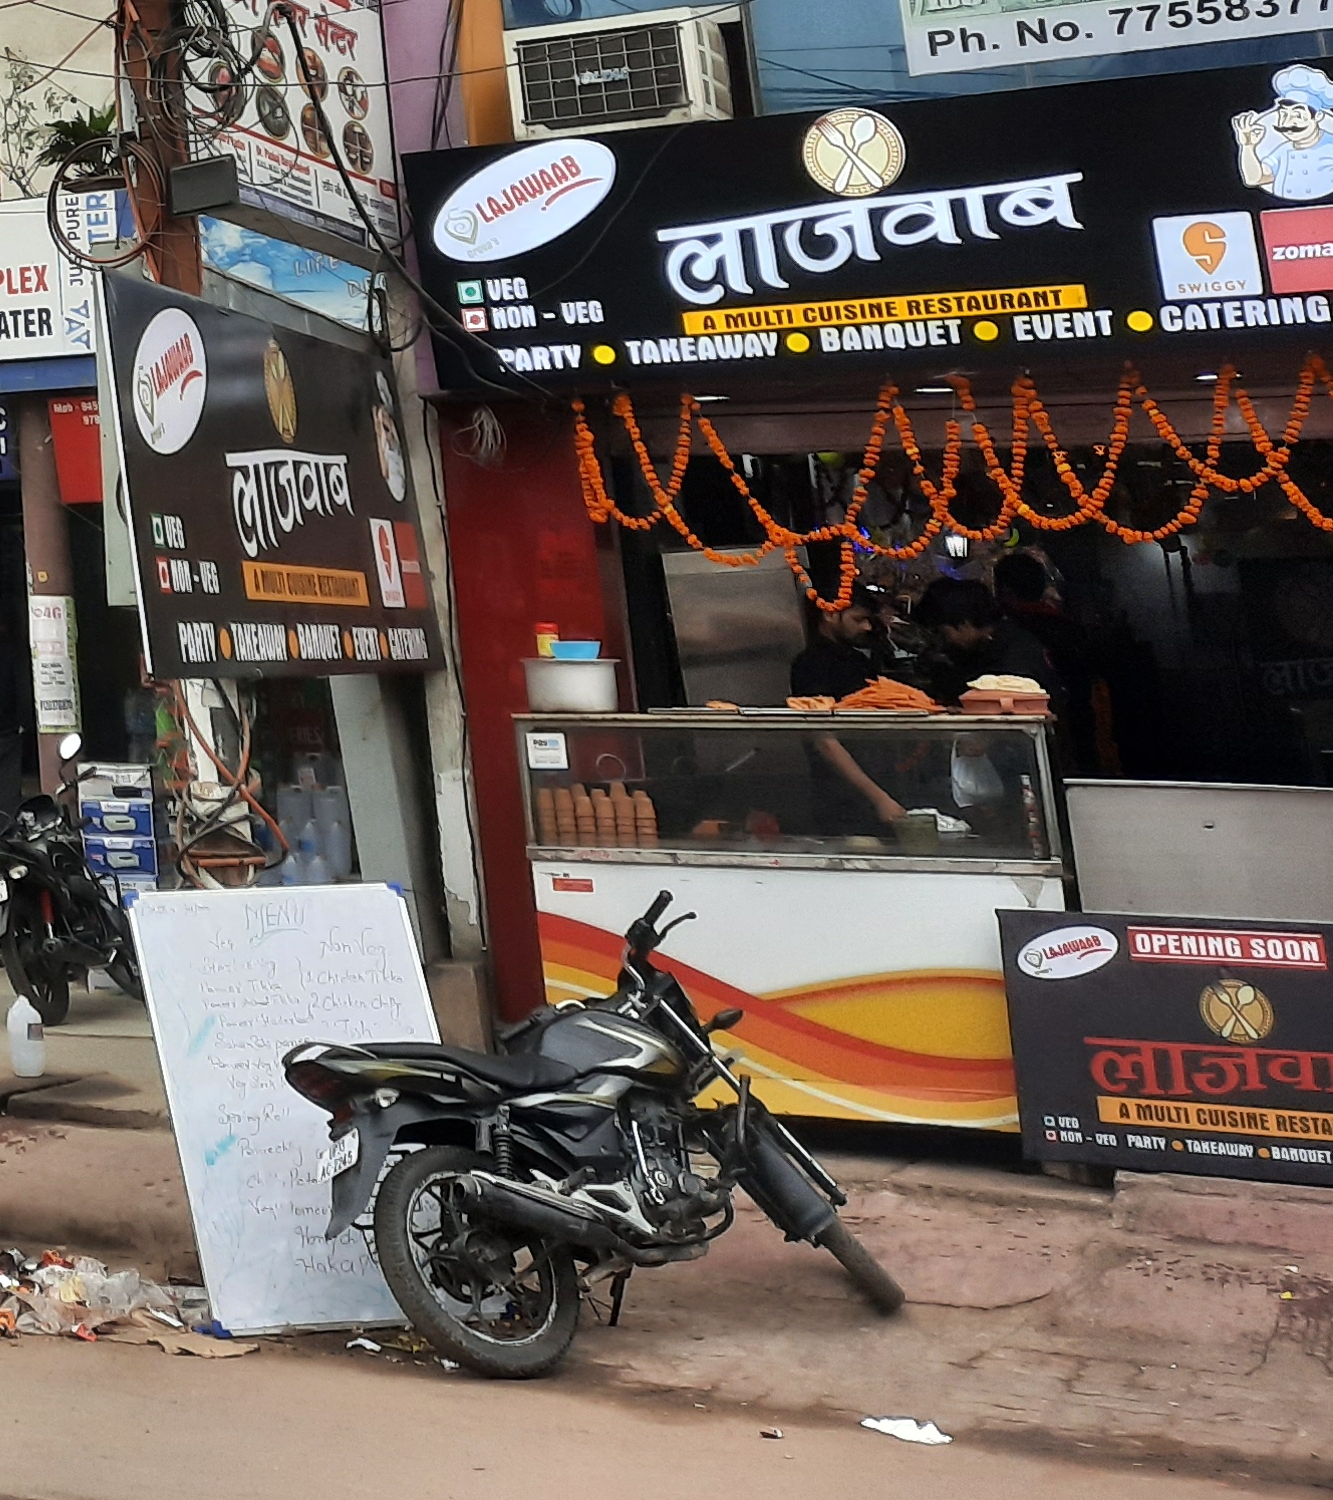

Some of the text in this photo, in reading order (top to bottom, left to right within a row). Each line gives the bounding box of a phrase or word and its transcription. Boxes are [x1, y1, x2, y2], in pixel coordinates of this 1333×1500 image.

[928, 18, 1093, 57] Ph. No.
[476, 155, 582, 223] LAJAWAAB
[66, 196, 82, 240] PURE
[656, 171, 1084, 305] लाजवाब
[486, 277, 528, 300] VEG
[1177, 279, 1247, 294] SWIGGY
[492, 301, 604, 330] NON VEG
[703, 289, 1062, 330] A MULTI CUISINE RESTAURANT
[499, 295, 1331, 373] PARTY TAKEAWAY BANQUET EVENT CATERING
[150, 332, 194, 398] LAJAWAAB
[225, 450, 355, 558] लाजवाब
[164, 514, 185, 549] VEG
[198, 560, 219, 594] VEG
[178, 622, 429, 662] PARTY TAKEAWAY BANQUET EVENT CATERING
[244, 901, 308, 936] MENU
[1042, 933, 1321, 963] LAJAWAAB OPENING SOON
[1058, 1116, 1080, 1129] VEG
[1119, 1103, 1271, 1132] A MULTI CUISINE
[1127, 1133, 1167, 1151] PARTY
[1185, 1139, 1254, 1159] TAKEAWAY
[1271, 1146, 1333, 1165] BANQUET
